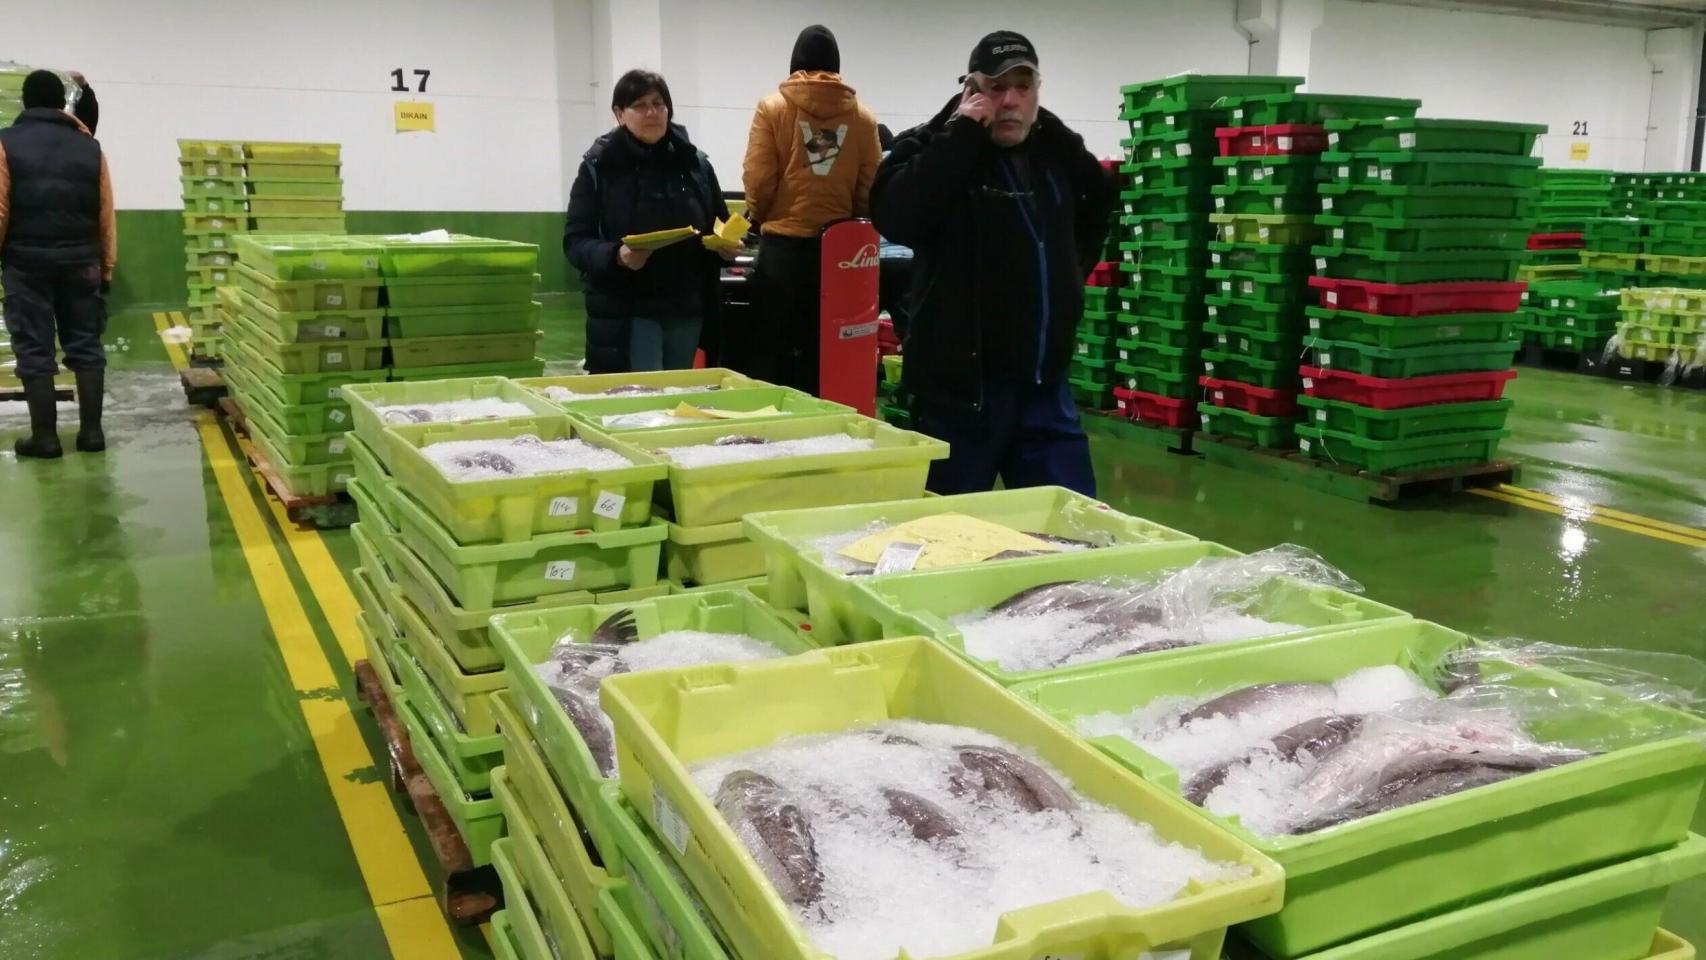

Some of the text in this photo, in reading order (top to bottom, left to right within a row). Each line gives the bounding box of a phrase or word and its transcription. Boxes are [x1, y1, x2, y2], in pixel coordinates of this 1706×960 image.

[391, 68, 431, 92] 17
[1572, 121, 1589, 136] 21
[600, 499, 617, 512] 66
